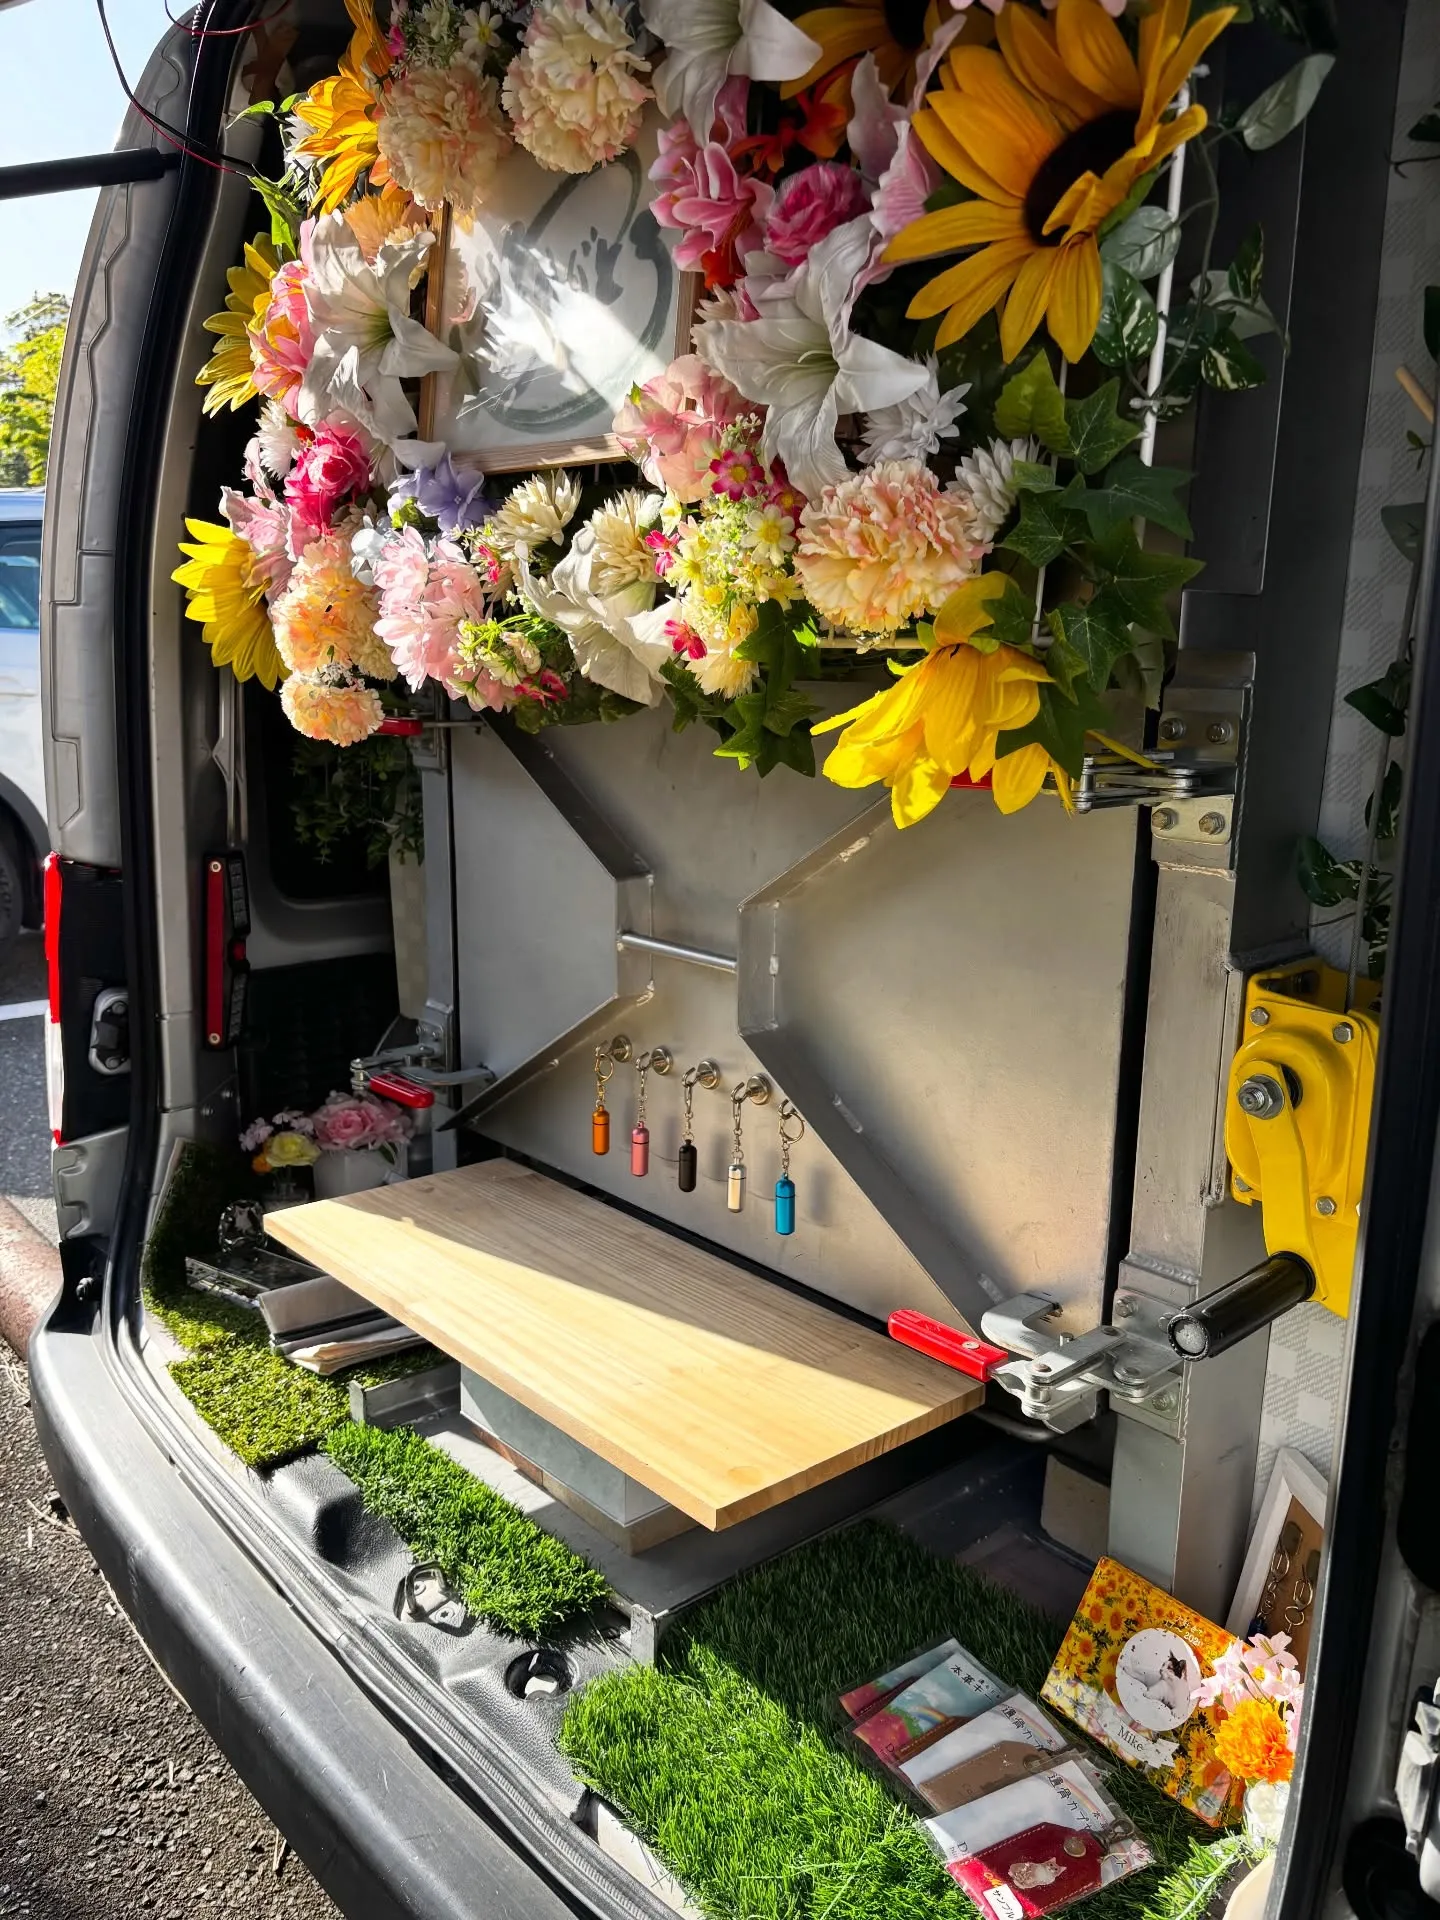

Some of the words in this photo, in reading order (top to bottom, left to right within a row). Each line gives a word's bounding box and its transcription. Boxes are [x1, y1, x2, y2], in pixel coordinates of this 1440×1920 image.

[1117, 1725, 1143, 1751] Mike
[993, 1889, 1015, 1919] サンプル
